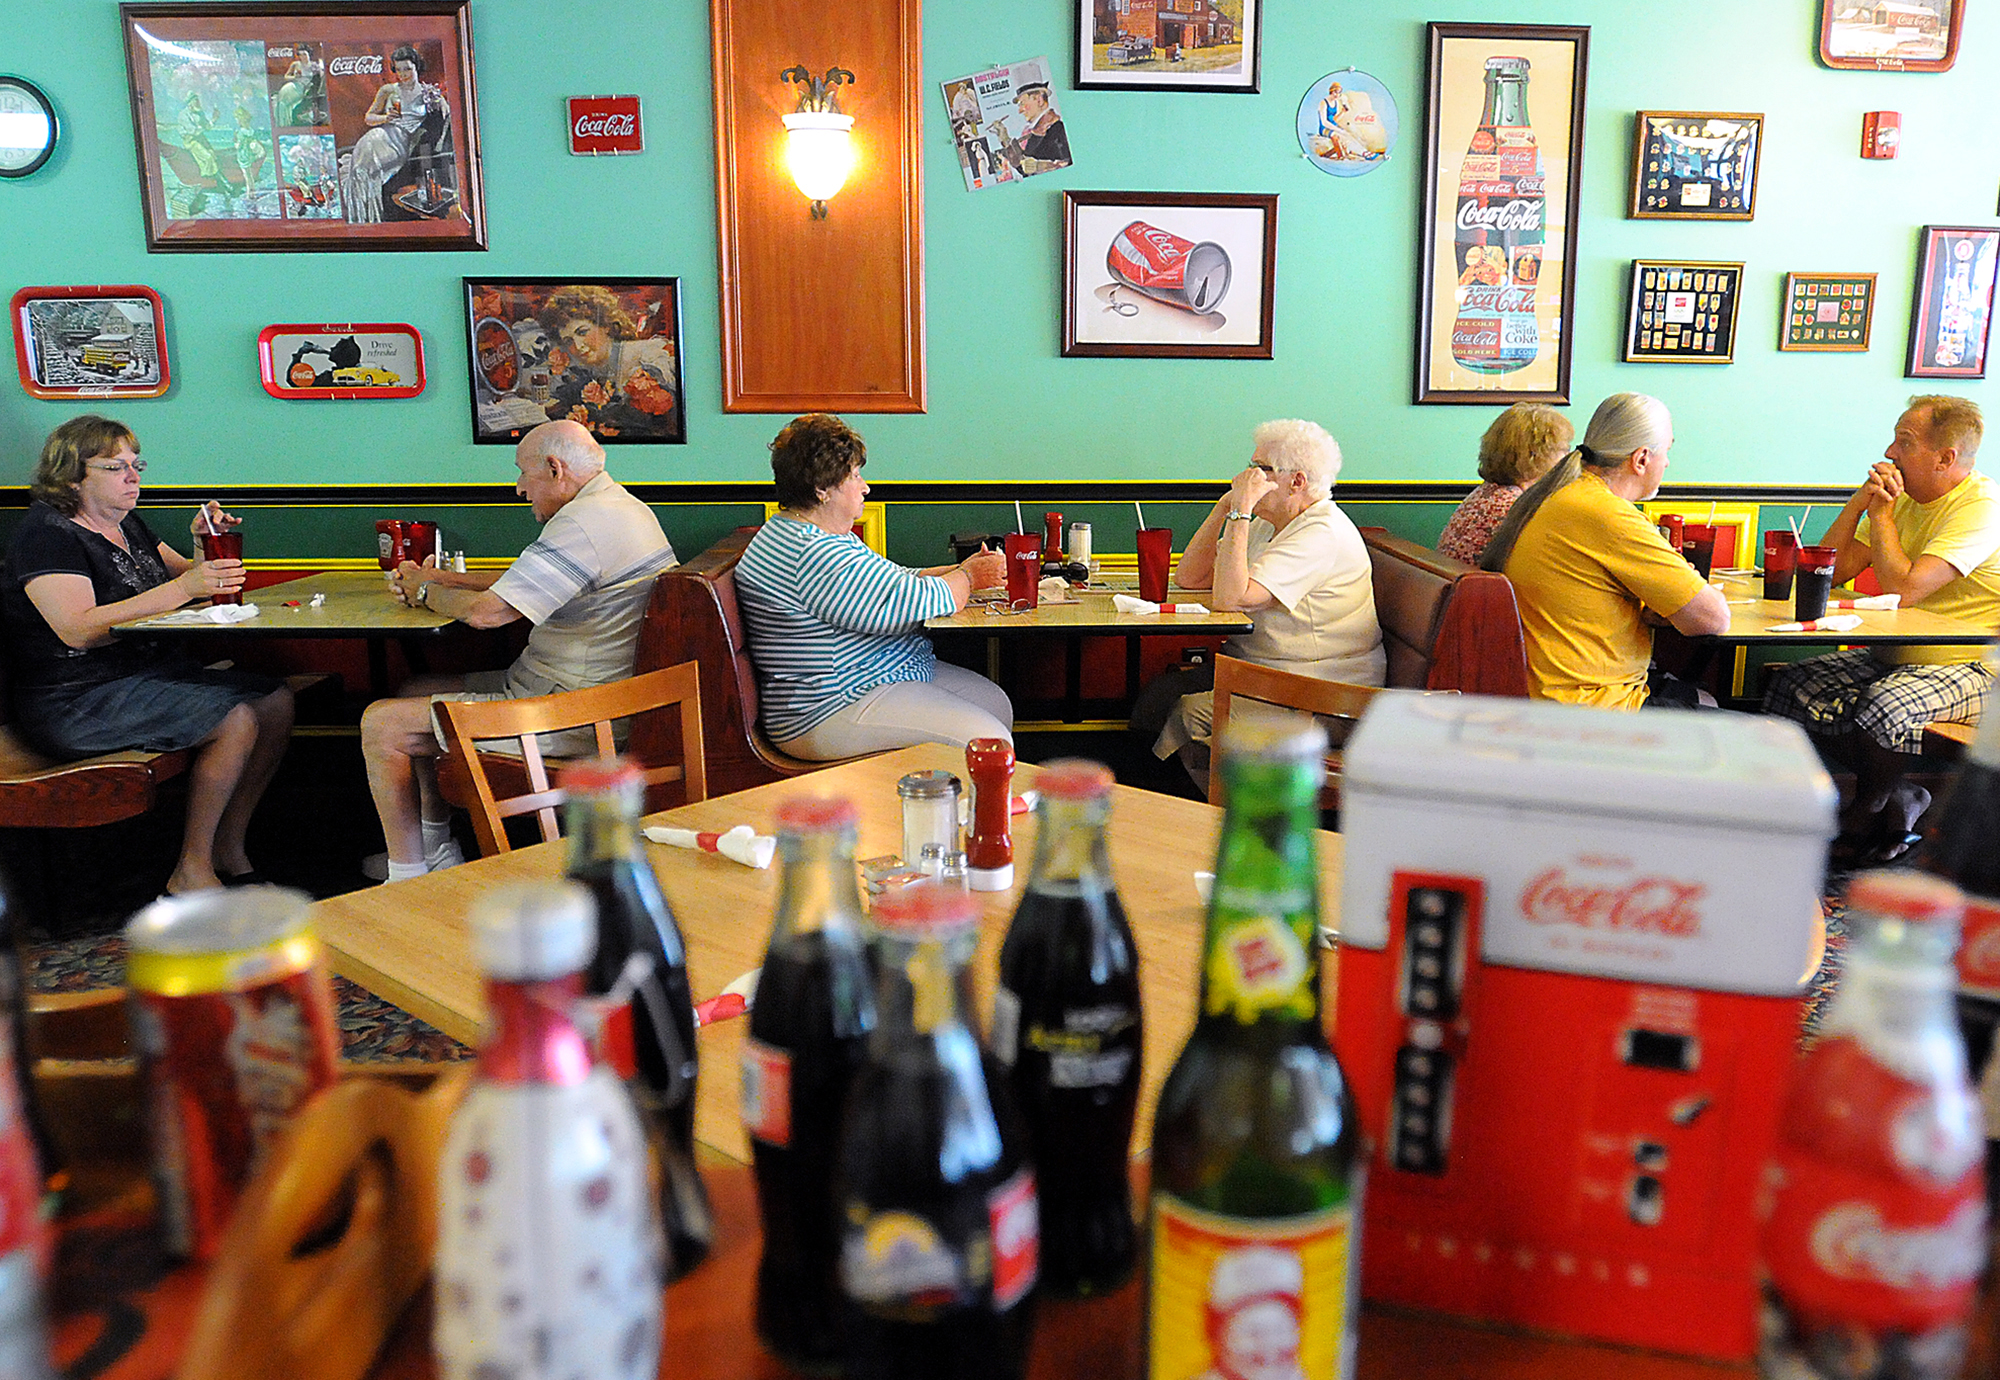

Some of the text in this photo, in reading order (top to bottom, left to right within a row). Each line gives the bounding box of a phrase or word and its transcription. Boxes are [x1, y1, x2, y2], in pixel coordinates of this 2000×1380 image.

[329, 55, 383, 76] Coca-Cola
[575, 114, 635, 137] Coca-Cola
[1457, 199, 1544, 231] Coca-Cola
[1452, 330, 1499, 345] Coca-Cola
[1505, 332, 1538, 344] Coke
[1515, 326, 1536, 335] with
[371, 340, 393, 349] Drive
[367, 348, 398, 357] refreshed
[1518, 864, 1706, 938] Coca-Cola
